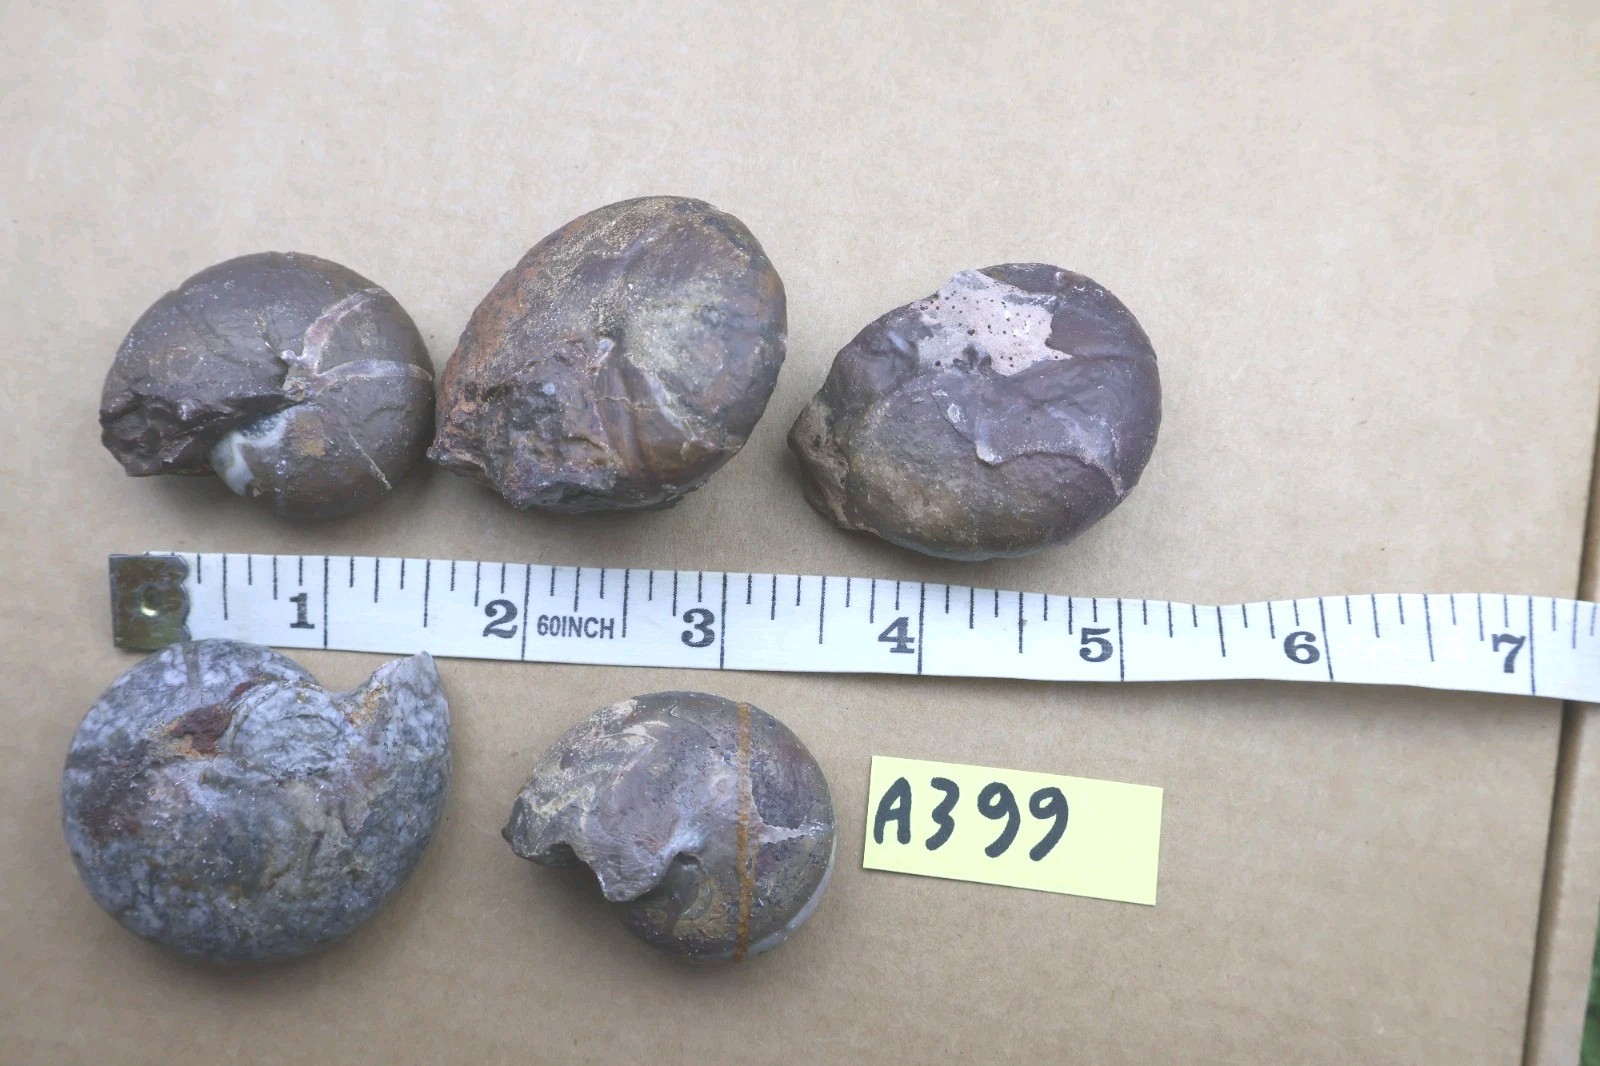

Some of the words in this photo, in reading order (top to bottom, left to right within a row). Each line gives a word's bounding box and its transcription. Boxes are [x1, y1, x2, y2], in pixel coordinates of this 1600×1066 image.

[288, 591, 316, 630] 1
[482, 599, 520, 639] 2
[537, 614, 616, 640] 60INCH
[680, 607, 717, 648] 3
[877, 617, 916, 655] 4
[1078, 627, 1114, 664] 5
[1283, 631, 1321, 666] 6
[1491, 633, 1527, 674] 7
[873, 776, 1069, 862] A399
